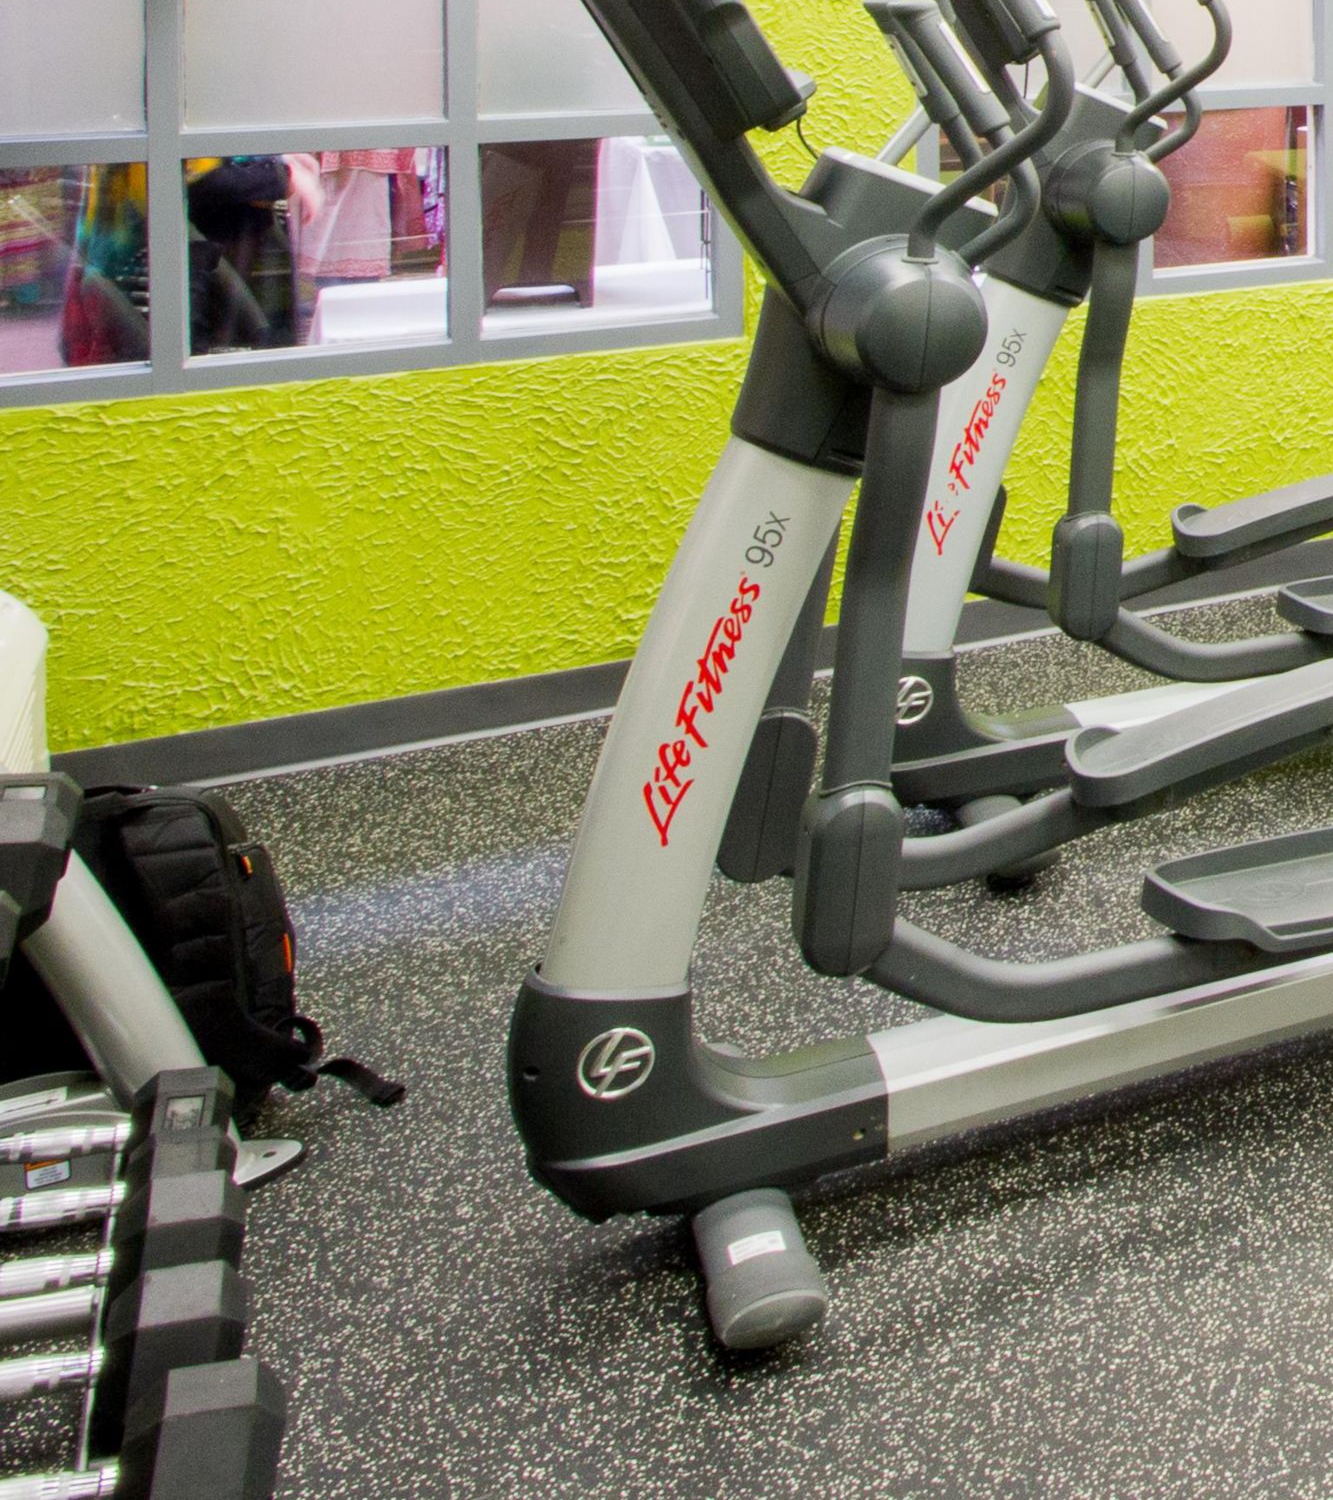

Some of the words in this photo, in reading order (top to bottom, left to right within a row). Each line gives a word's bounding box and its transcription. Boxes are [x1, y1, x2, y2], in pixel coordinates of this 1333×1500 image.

[948, 373, 1008, 490] Fitness
[642, 739, 695, 848] Life
[675, 576, 761, 749] Fitness
